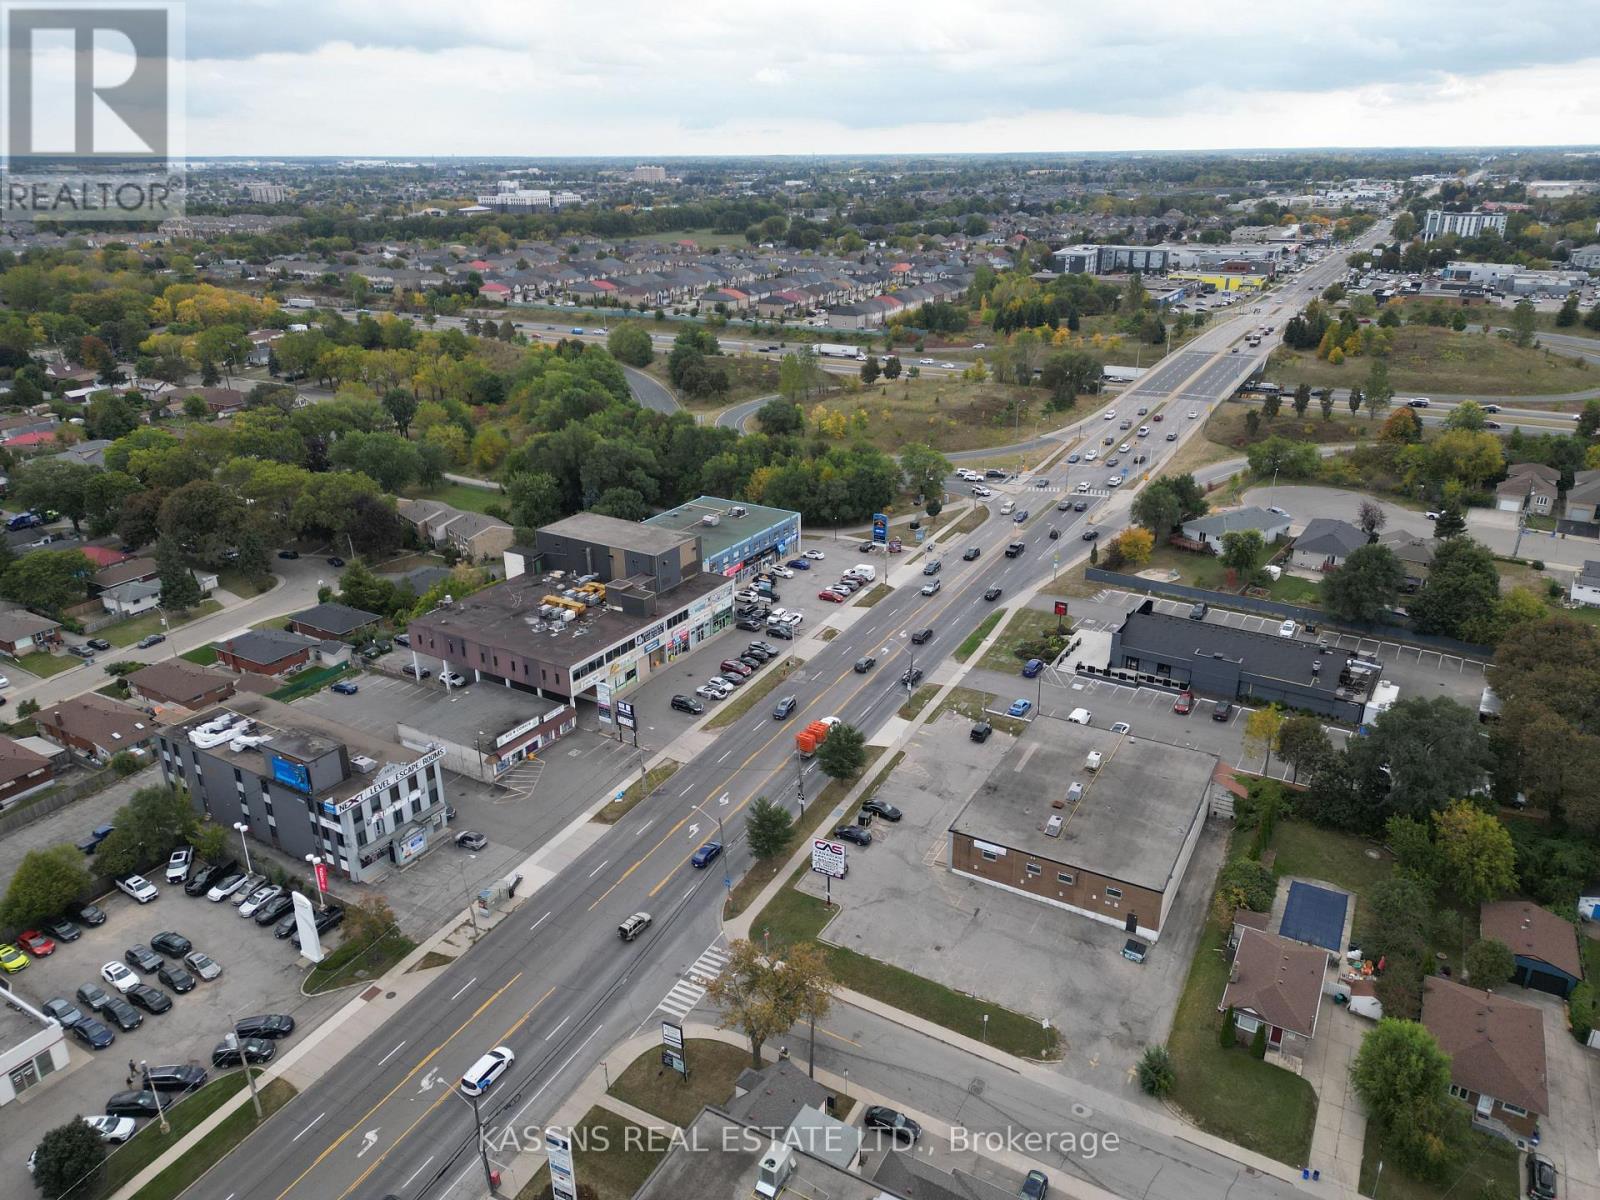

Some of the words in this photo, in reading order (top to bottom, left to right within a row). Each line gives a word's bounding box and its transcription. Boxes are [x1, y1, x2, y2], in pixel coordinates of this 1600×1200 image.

[339, 793, 365, 812] NEXT
[369, 779, 391, 795] LEVEL
[395, 763, 419, 780] ESCAPE
[422, 748, 444, 765] ROOMS
[815, 841, 843, 855] CAS
